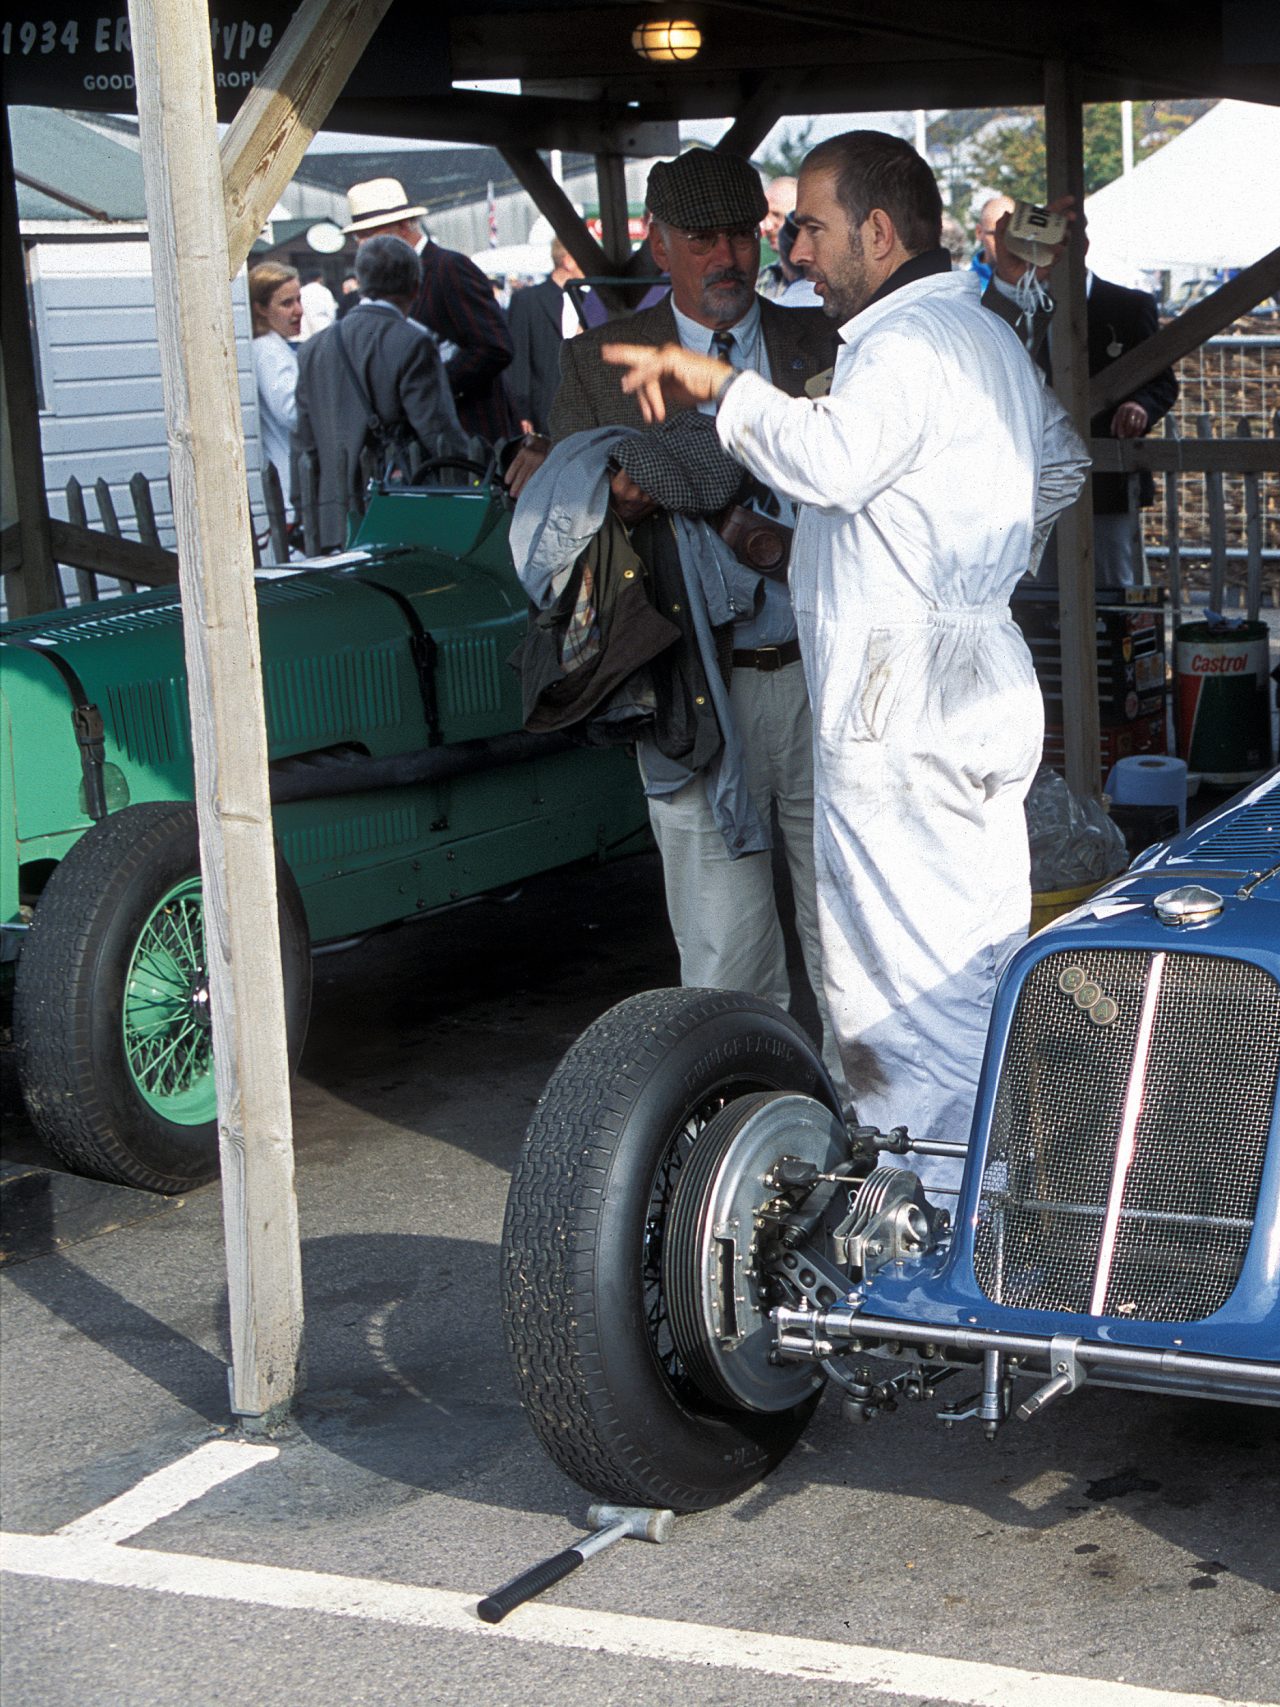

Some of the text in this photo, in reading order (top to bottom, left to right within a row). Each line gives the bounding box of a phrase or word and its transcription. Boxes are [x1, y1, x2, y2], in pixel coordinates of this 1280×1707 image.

[1, 20, 79, 55] 1934
[95, 17, 131, 53] ER
[83, 75, 137, 91] GOOD
[1191, 653, 1249, 673] Castrol
